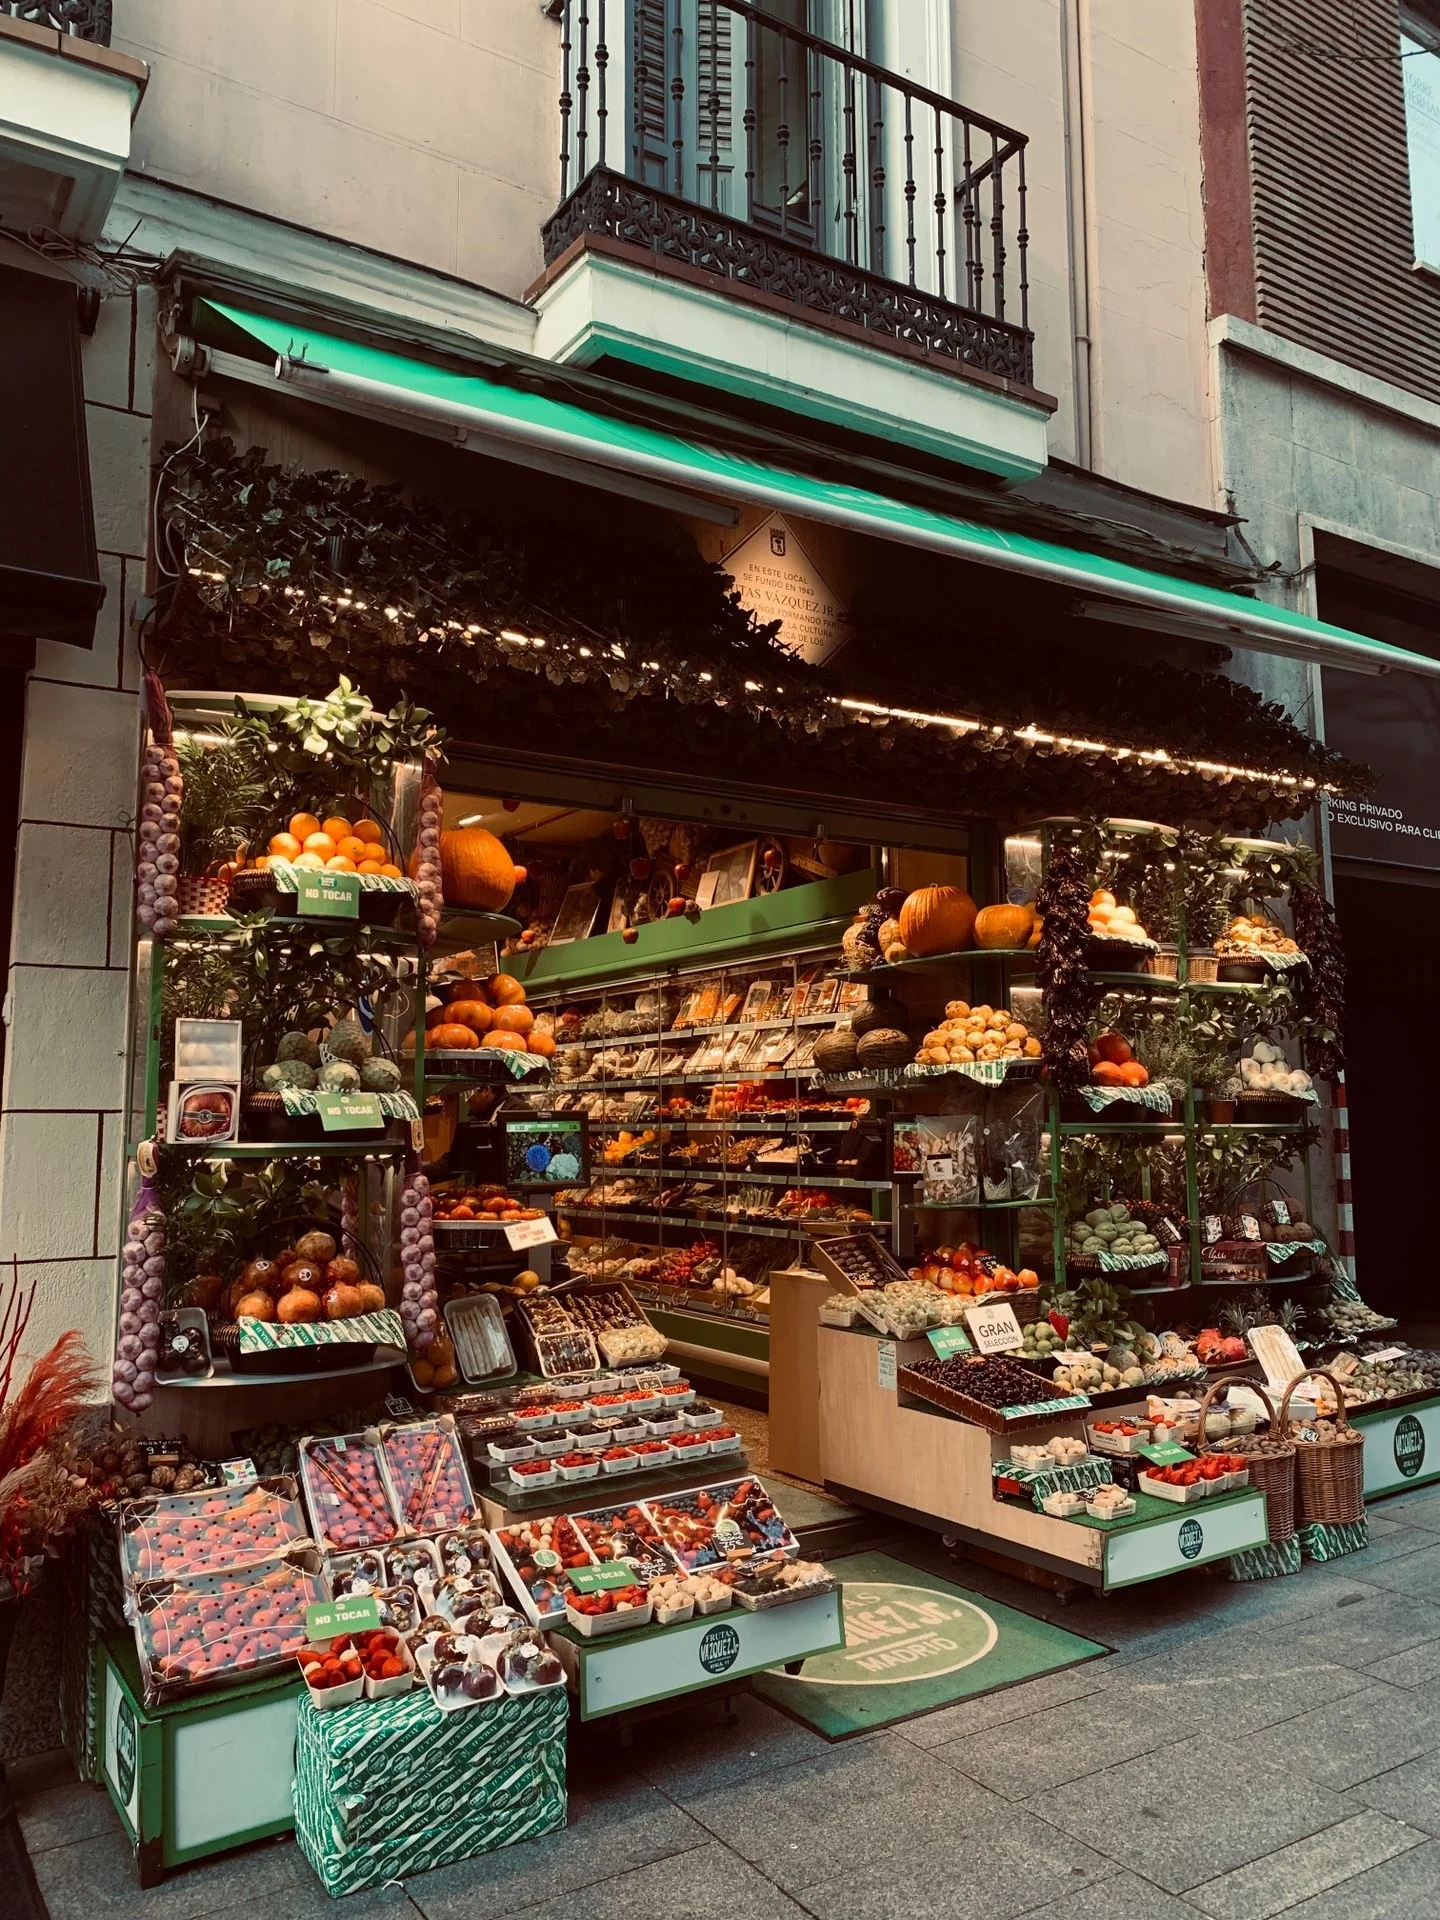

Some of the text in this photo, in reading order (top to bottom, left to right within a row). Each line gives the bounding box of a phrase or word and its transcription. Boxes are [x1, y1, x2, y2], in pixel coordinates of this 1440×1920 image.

[750, 564, 808, 584] EN ESTE LOCAL
[743, 573, 752, 582] SE
[785, 583, 796, 592] EN
[798, 586, 814, 596] 1943
[777, 609, 821, 626] FORMANDO
[799, 634, 807, 642] DE
[800, 625, 833, 638] CULTURA
[1360, 803, 1403, 820] PRIVADO
[1337, 813, 1393, 831] EXCLUSIVO
[1395, 823, 1421, 836] PARA
[305, 888, 352, 901] NO TOCAR
[327, 1105, 373, 1115] NO TOCAR
[978, 1321, 1015, 1338] GRAN
[578, 1570, 626, 1582] NO TOCAR
[315, 1609, 370, 1625] NO TOCAR
[705, 1629, 734, 1643] FRUTAS
[856, 1638, 958, 1672] MADRID
